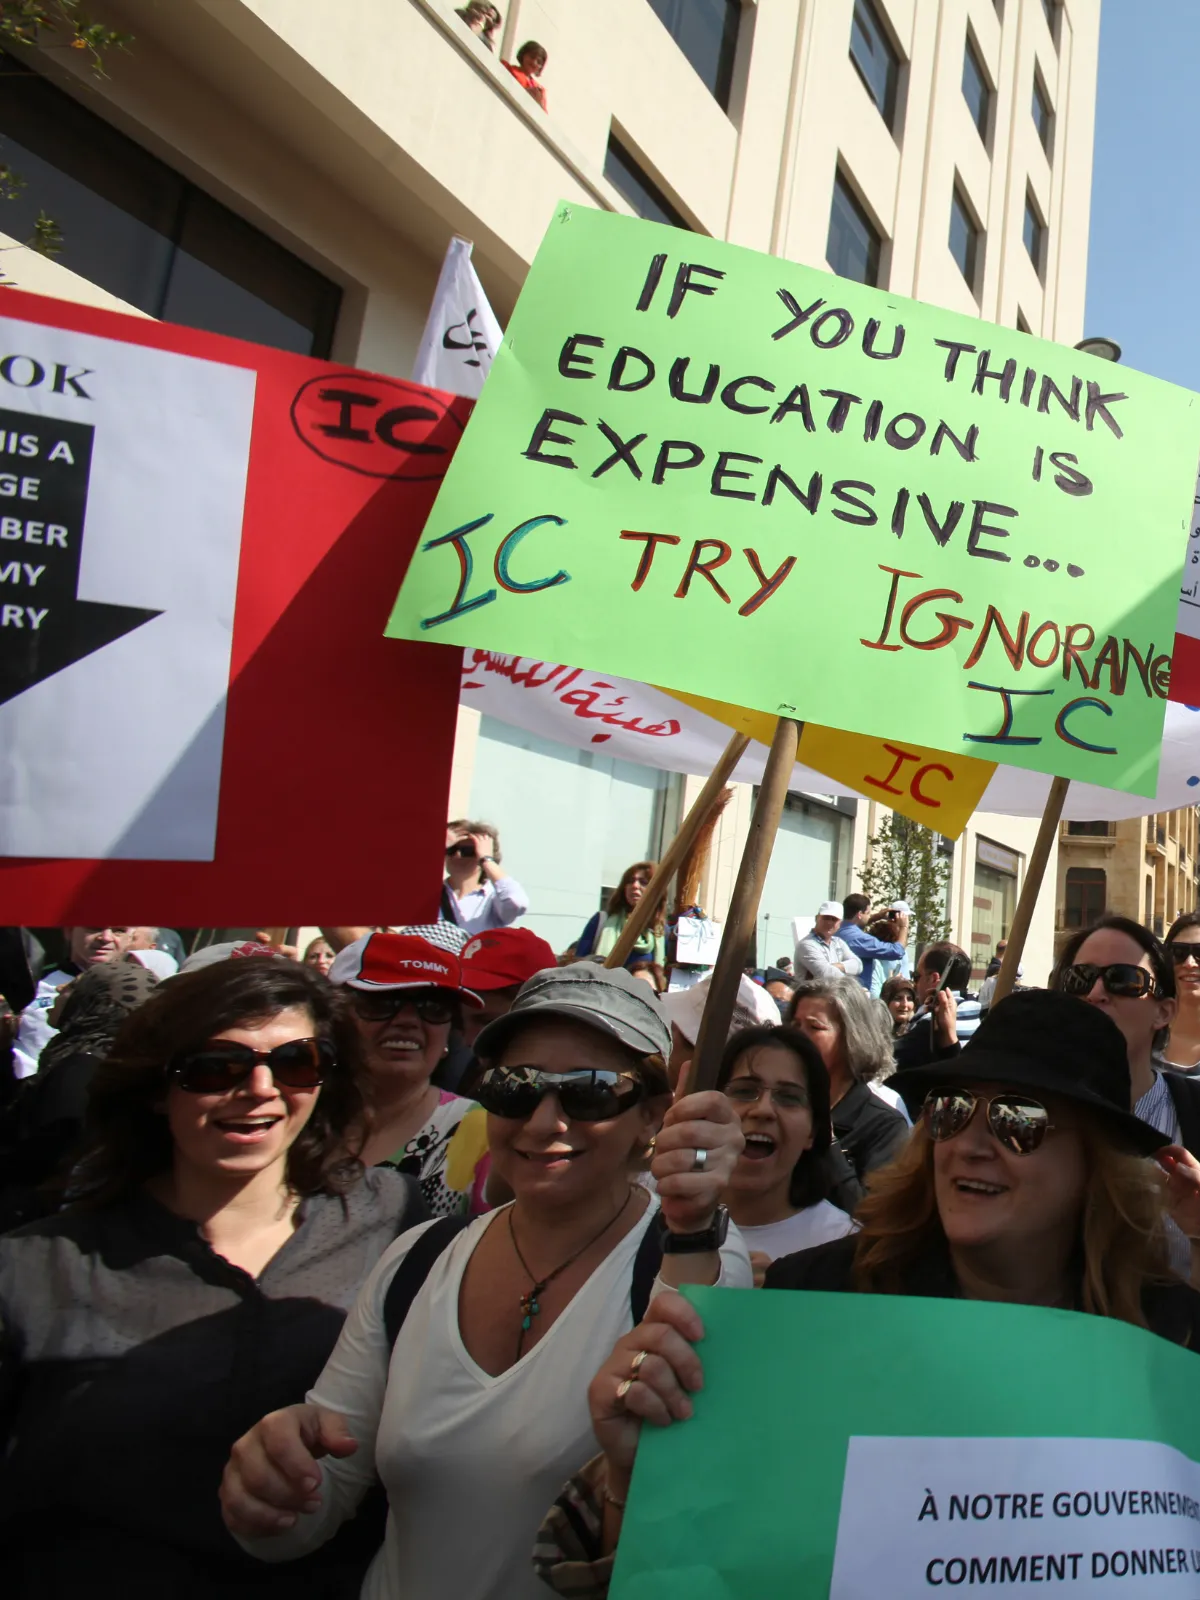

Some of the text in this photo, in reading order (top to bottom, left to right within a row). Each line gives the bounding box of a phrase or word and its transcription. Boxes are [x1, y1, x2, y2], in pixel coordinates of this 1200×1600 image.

[636, 253, 1128, 438] IF YOU THINK
[319, 388, 448, 455] IC
[558, 334, 978, 462] EDUCATION
[1033, 446, 1093, 496] IS
[49, 441, 74, 465] A
[1, 517, 68, 548] BER
[421, 513, 571, 630] IC
[619, 530, 797, 617] TRY
[2, 605, 49, 631] RY
[963, 681, 1118, 755] IC
[863, 743, 954, 808] IC
[400, 958, 449, 975] TOMMY
[918, 1488, 939, 1521] À
[948, 1493, 1044, 1520] NOTRE
[925, 1553, 1083, 1586] COMMENT
[1091, 1548, 1188, 1578] DONNER
